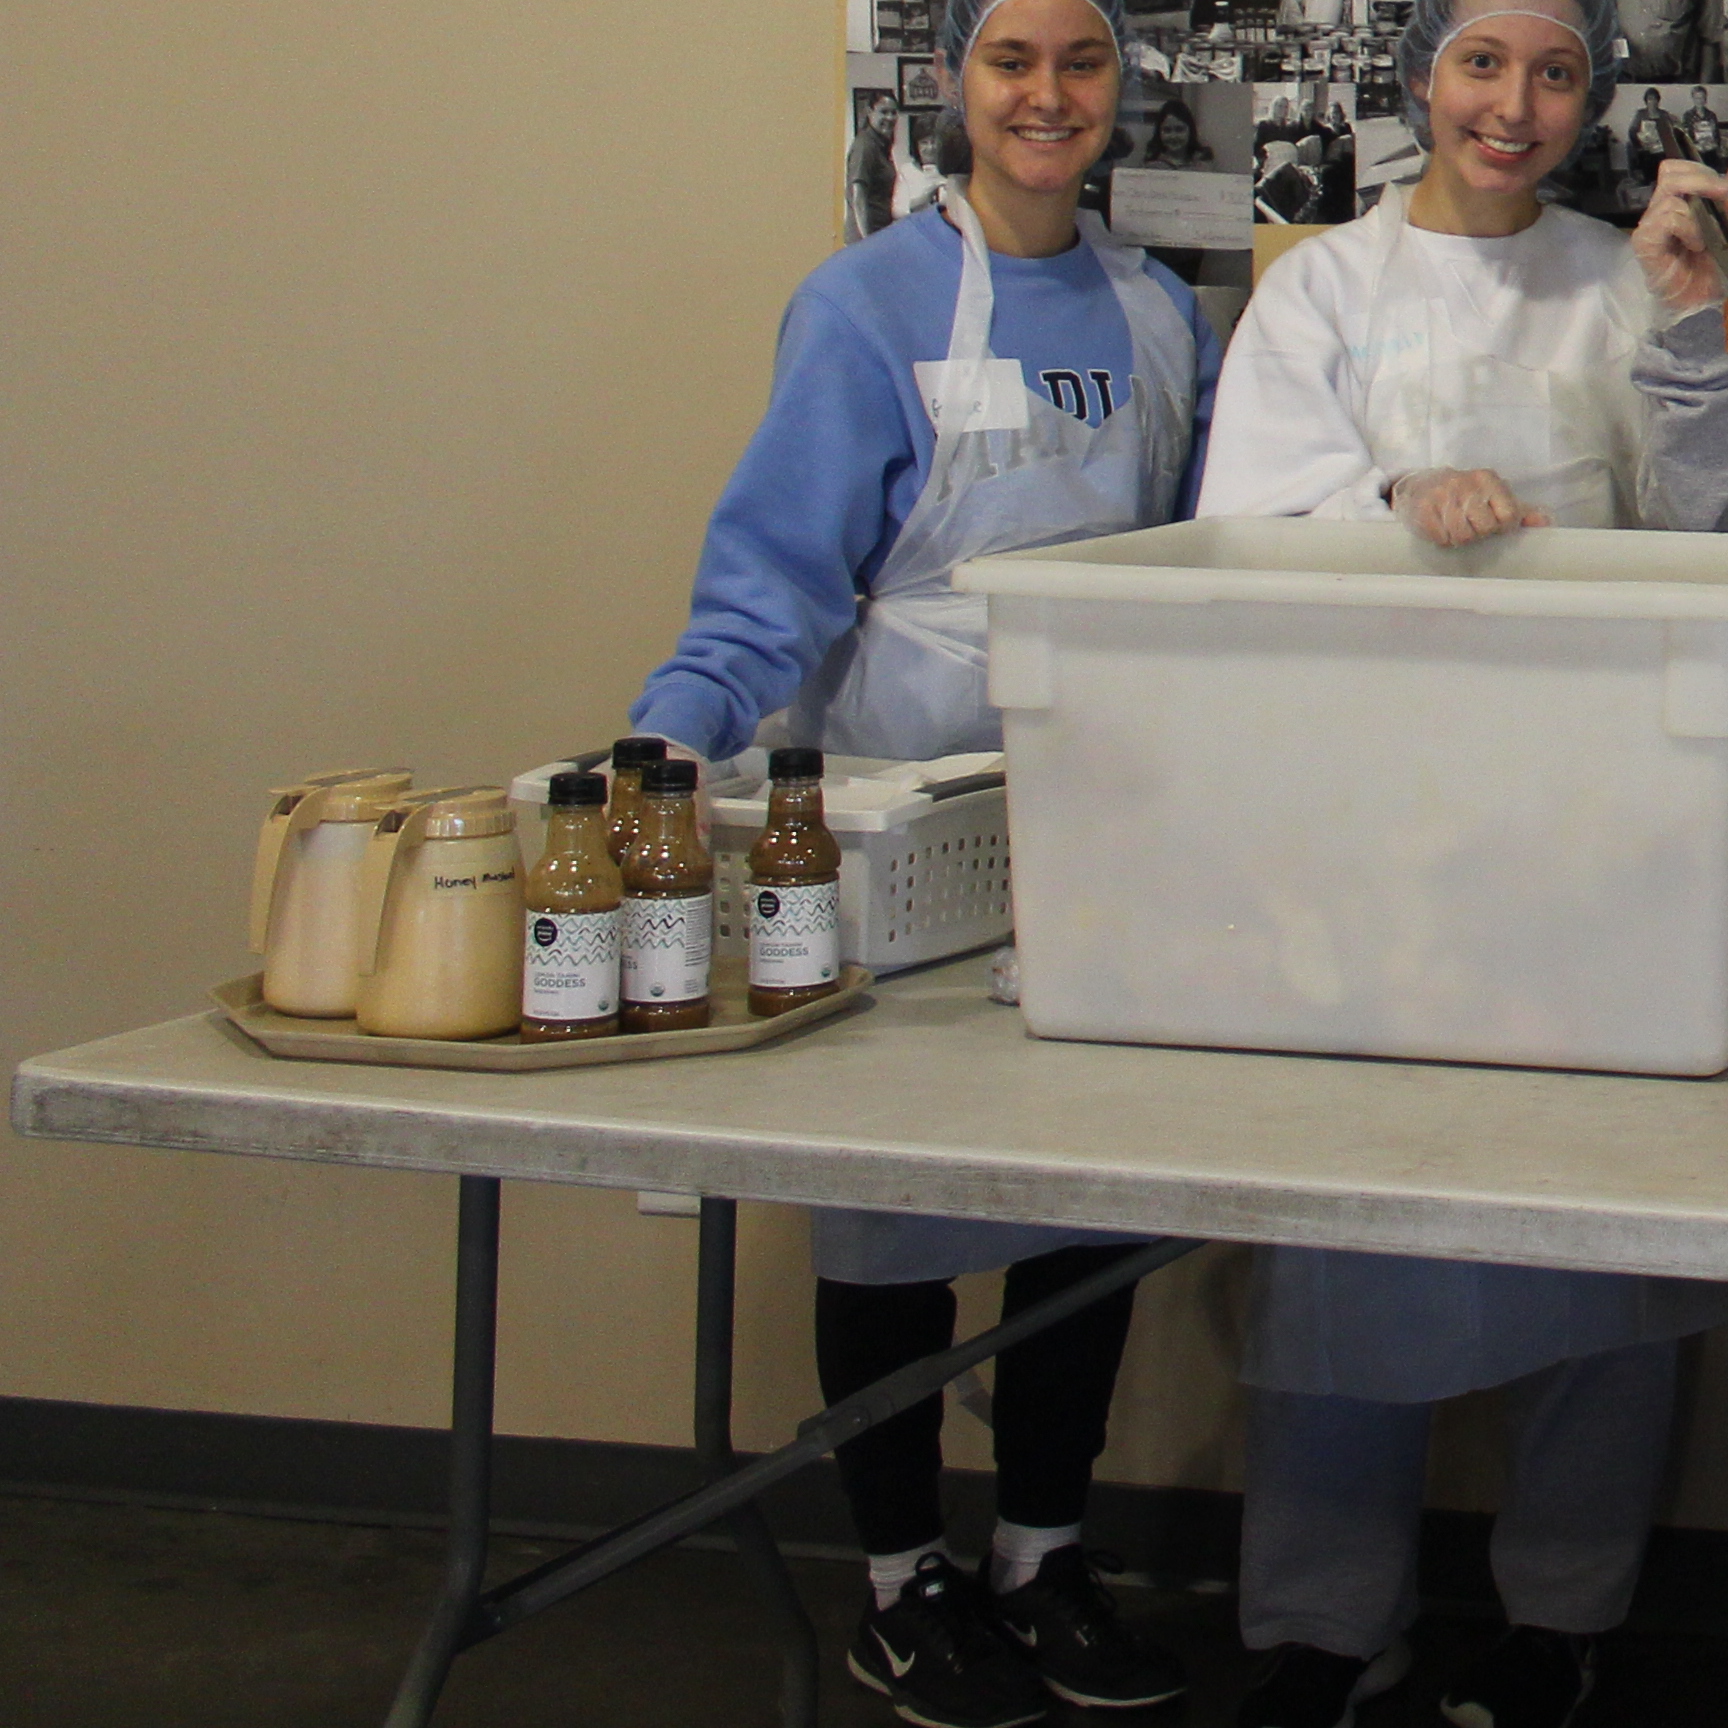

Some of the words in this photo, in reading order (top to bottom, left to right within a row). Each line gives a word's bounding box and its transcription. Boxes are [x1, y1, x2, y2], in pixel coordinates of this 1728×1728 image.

[434, 874, 478, 891] Honey
[759, 947, 809, 957] GODDESS
[534, 977, 586, 988] GODDESS
